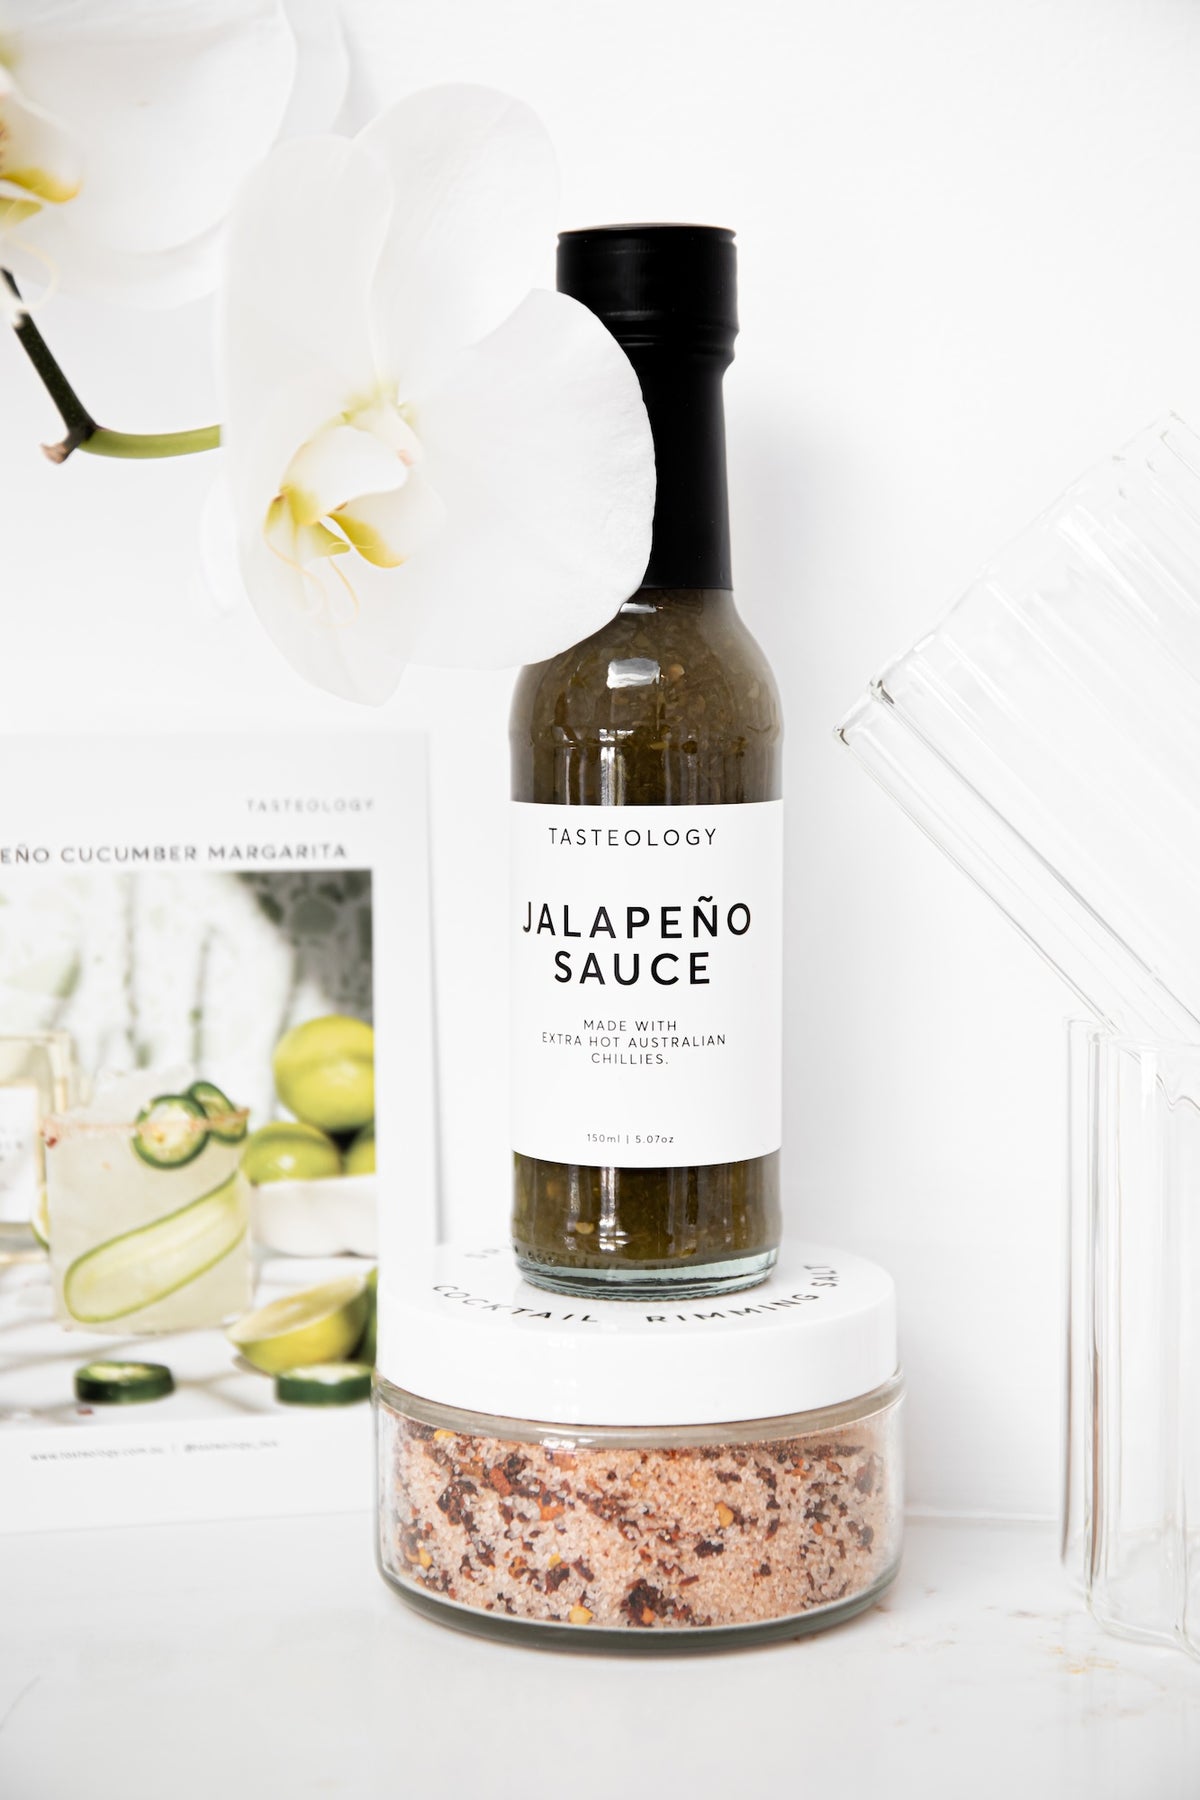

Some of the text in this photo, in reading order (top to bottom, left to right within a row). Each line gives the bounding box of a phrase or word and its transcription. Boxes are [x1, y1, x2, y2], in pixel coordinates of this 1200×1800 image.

[246, 798, 375, 814] TASTEOLOGY
[548, 827, 716, 847] TASTEOLOGY
[0, 843, 347, 864] EÑO CUCUMBER MARGARITA
[522, 895, 751, 940] JALAPEÑO
[554, 950, 711, 986] SAUCE
[583, 1019, 677, 1032] MADE WITH
[542, 1031, 726, 1049] EXTRA HOT AUSTRALIAN
[591, 1052, 669, 1065] CHILLIES.
[587, 1133, 620, 1144] 150ml
[635, 1134, 675, 1145] 5.07oz
[432, 1265, 840, 1323] COCKTAIL RIMMING SALT
